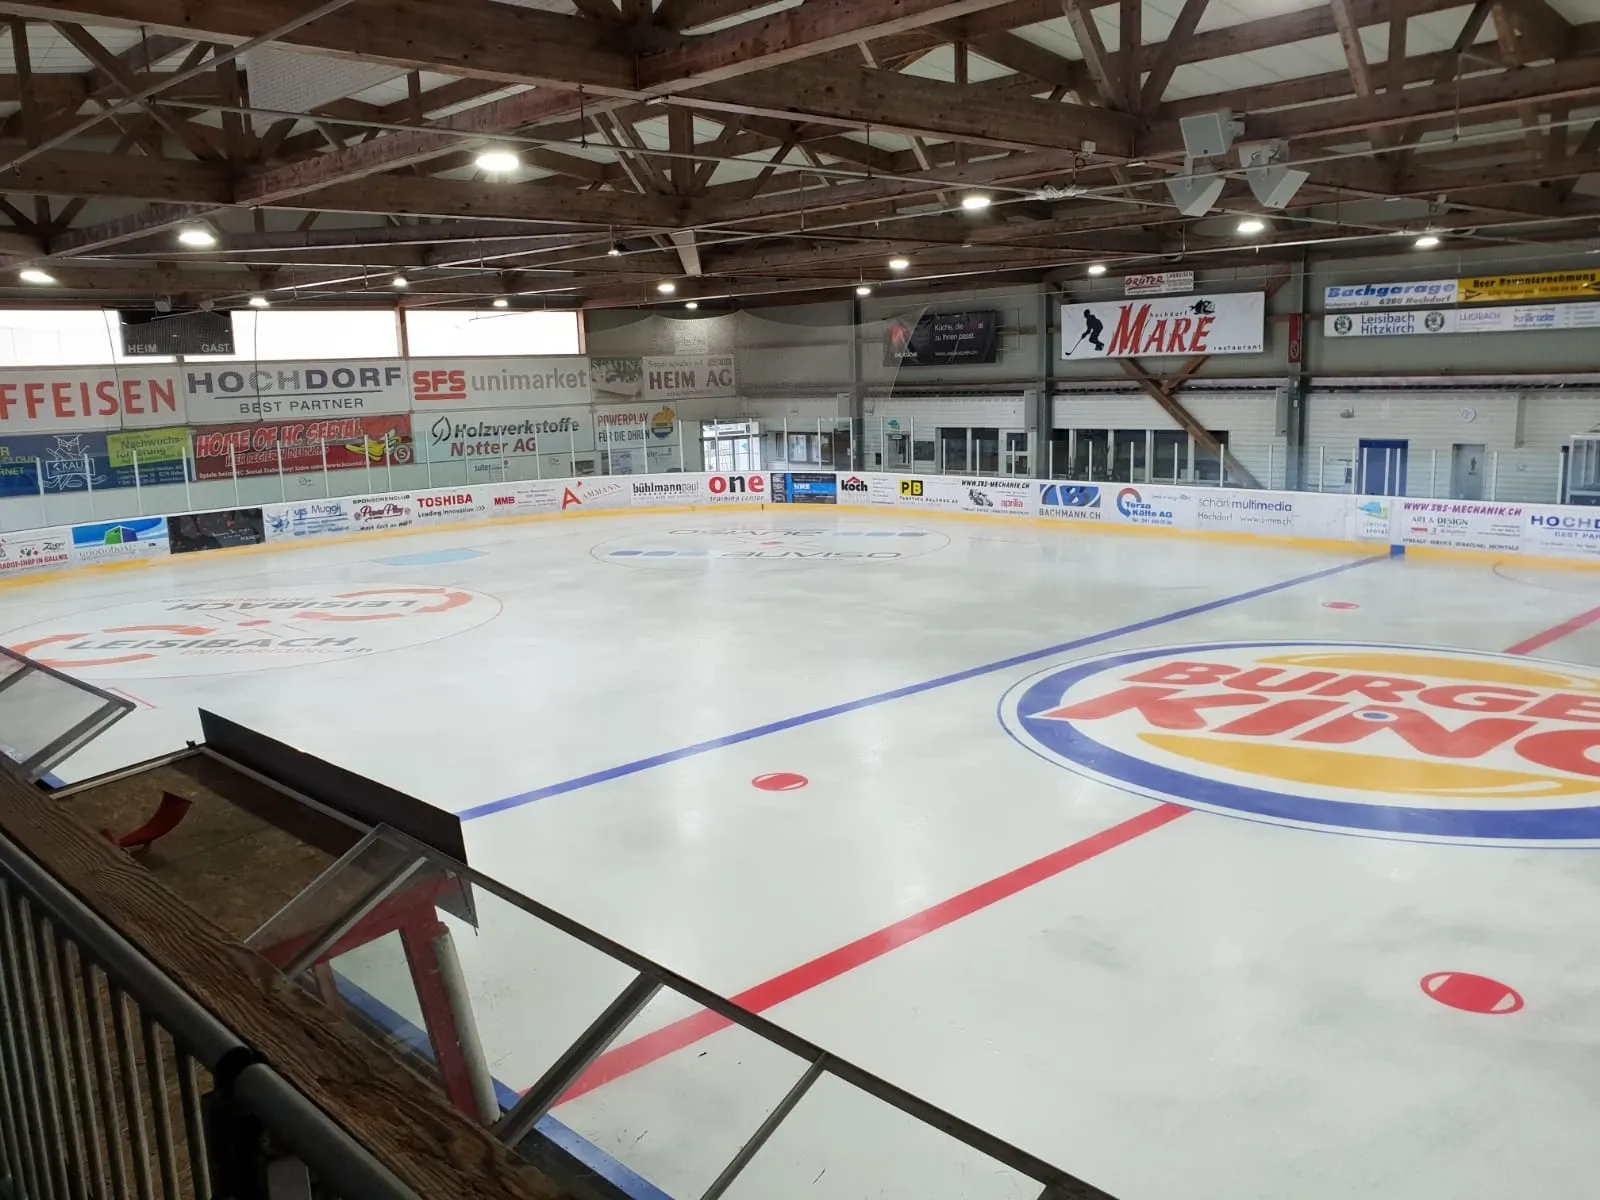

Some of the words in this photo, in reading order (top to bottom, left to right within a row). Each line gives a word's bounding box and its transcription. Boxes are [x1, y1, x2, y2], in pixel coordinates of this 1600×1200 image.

[1473, 279, 1496, 288] Beer
[1327, 283, 1456, 299] Bachgarage
[1361, 312, 1415, 324] Leisibach
[1106, 302, 1216, 356] MARE
[1361, 324, 1415, 335] Hitzkirch
[128, 344, 157, 353] HEIM
[202, 343, 231, 353] GAST
[187, 367, 401, 394] HOCHDORF
[413, 369, 466, 394] SFS
[471, 368, 587, 392] unimarket
[648, 370, 696, 390] HEIM
[706, 369, 733, 388] AG
[239, 401, 282, 414] BEST
[289, 398, 364, 412] PARTNER
[597, 413, 649, 427] POWERPLAY
[454, 417, 579, 439] Holzwerkstoffe
[614, 429, 627, 441] DIE
[196, 429, 250, 459] HOME
[252, 426, 279, 452] OF
[281, 424, 305, 448] HC
[450, 442, 509, 457] Notter
[513, 438, 537, 453] AG
[709, 475, 764, 494] one
[841, 479, 868, 492] koch
[417, 493, 473, 508] TOSHIBA
[1231, 499, 1293, 512] multimedia
[418, 509, 442, 518] Leading
[1039, 508, 1101, 520] BACHMANN.CH
[1403, 502, 1523, 516] WWW.SBS-MECHANIK.CH
[1198, 512, 1233, 521] Hochdorf
[1437, 517, 1469, 526] DESIGN
[65, 637, 358, 651] LEISIBACH
